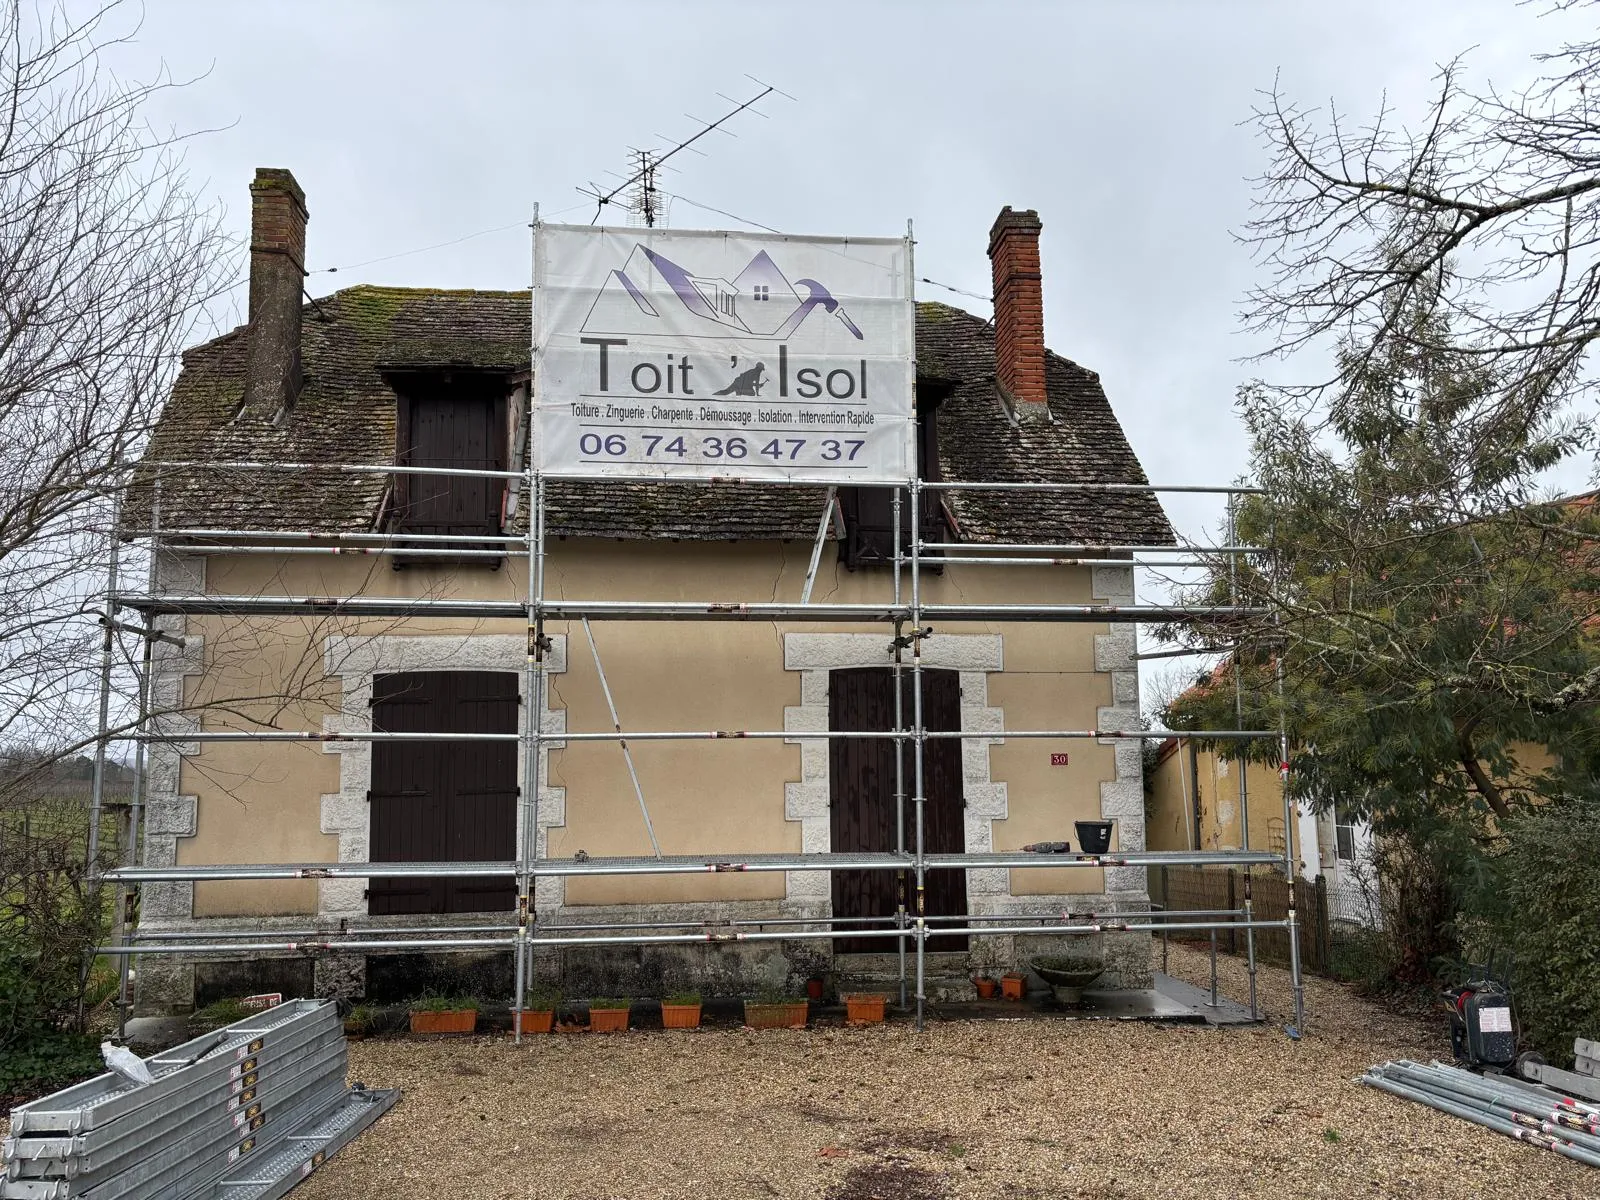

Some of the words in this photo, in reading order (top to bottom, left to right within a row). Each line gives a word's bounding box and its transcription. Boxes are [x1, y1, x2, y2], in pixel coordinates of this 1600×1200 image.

[580, 337, 694, 395] Toit
[779, 344, 867, 399] Isol
[571, 402, 600, 418] Toiture
[606, 404, 645, 422] Zinguerie
[651, 405, 693, 423] Charpente
[700, 407, 752, 426] Démoussage
[758, 409, 792, 423] Isolation
[799, 410, 846, 425] Intervention
[847, 410, 875, 427] Rapide
[579, 433, 627, 455] 06
[641, 435, 688, 457] 74
[702, 437, 748, 459] 36
[760, 438, 806, 460] 47
[820, 439, 865, 461] 37
[1053, 755, 1066, 764] 30
